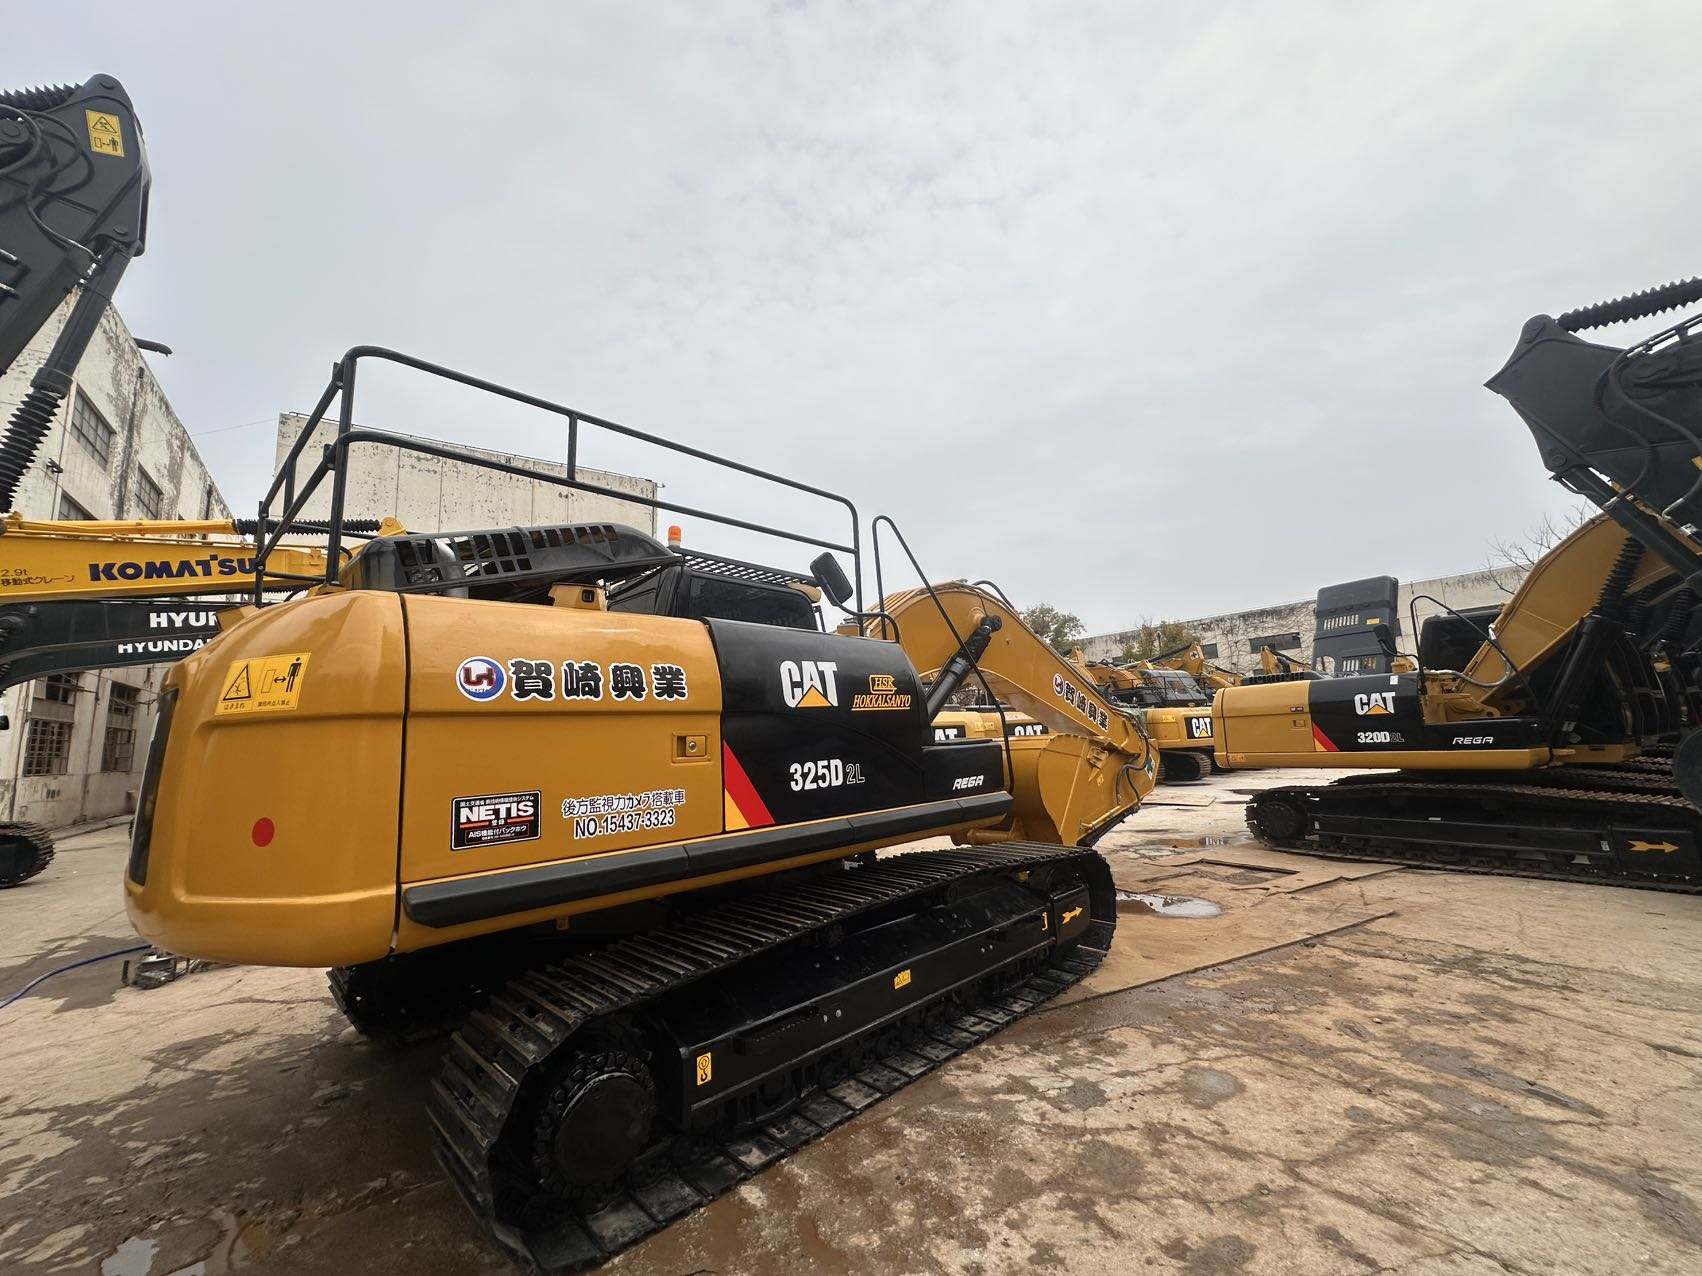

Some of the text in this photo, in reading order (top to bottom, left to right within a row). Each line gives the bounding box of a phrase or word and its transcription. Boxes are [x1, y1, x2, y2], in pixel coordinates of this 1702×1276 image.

[88, 554, 257, 581] KOMATSU
[779, 660, 839, 708] CAT
[1354, 691, 1396, 715] CAT
[934, 728, 957, 741] AT
[1191, 717, 1212, 738] CAT
[1357, 732, 1390, 743] 320D
[1452, 736, 1494, 745] REGA
[789, 758, 843, 791] 325D
[952, 775, 985, 790] REGA
[460, 801, 534, 823] NETIS
